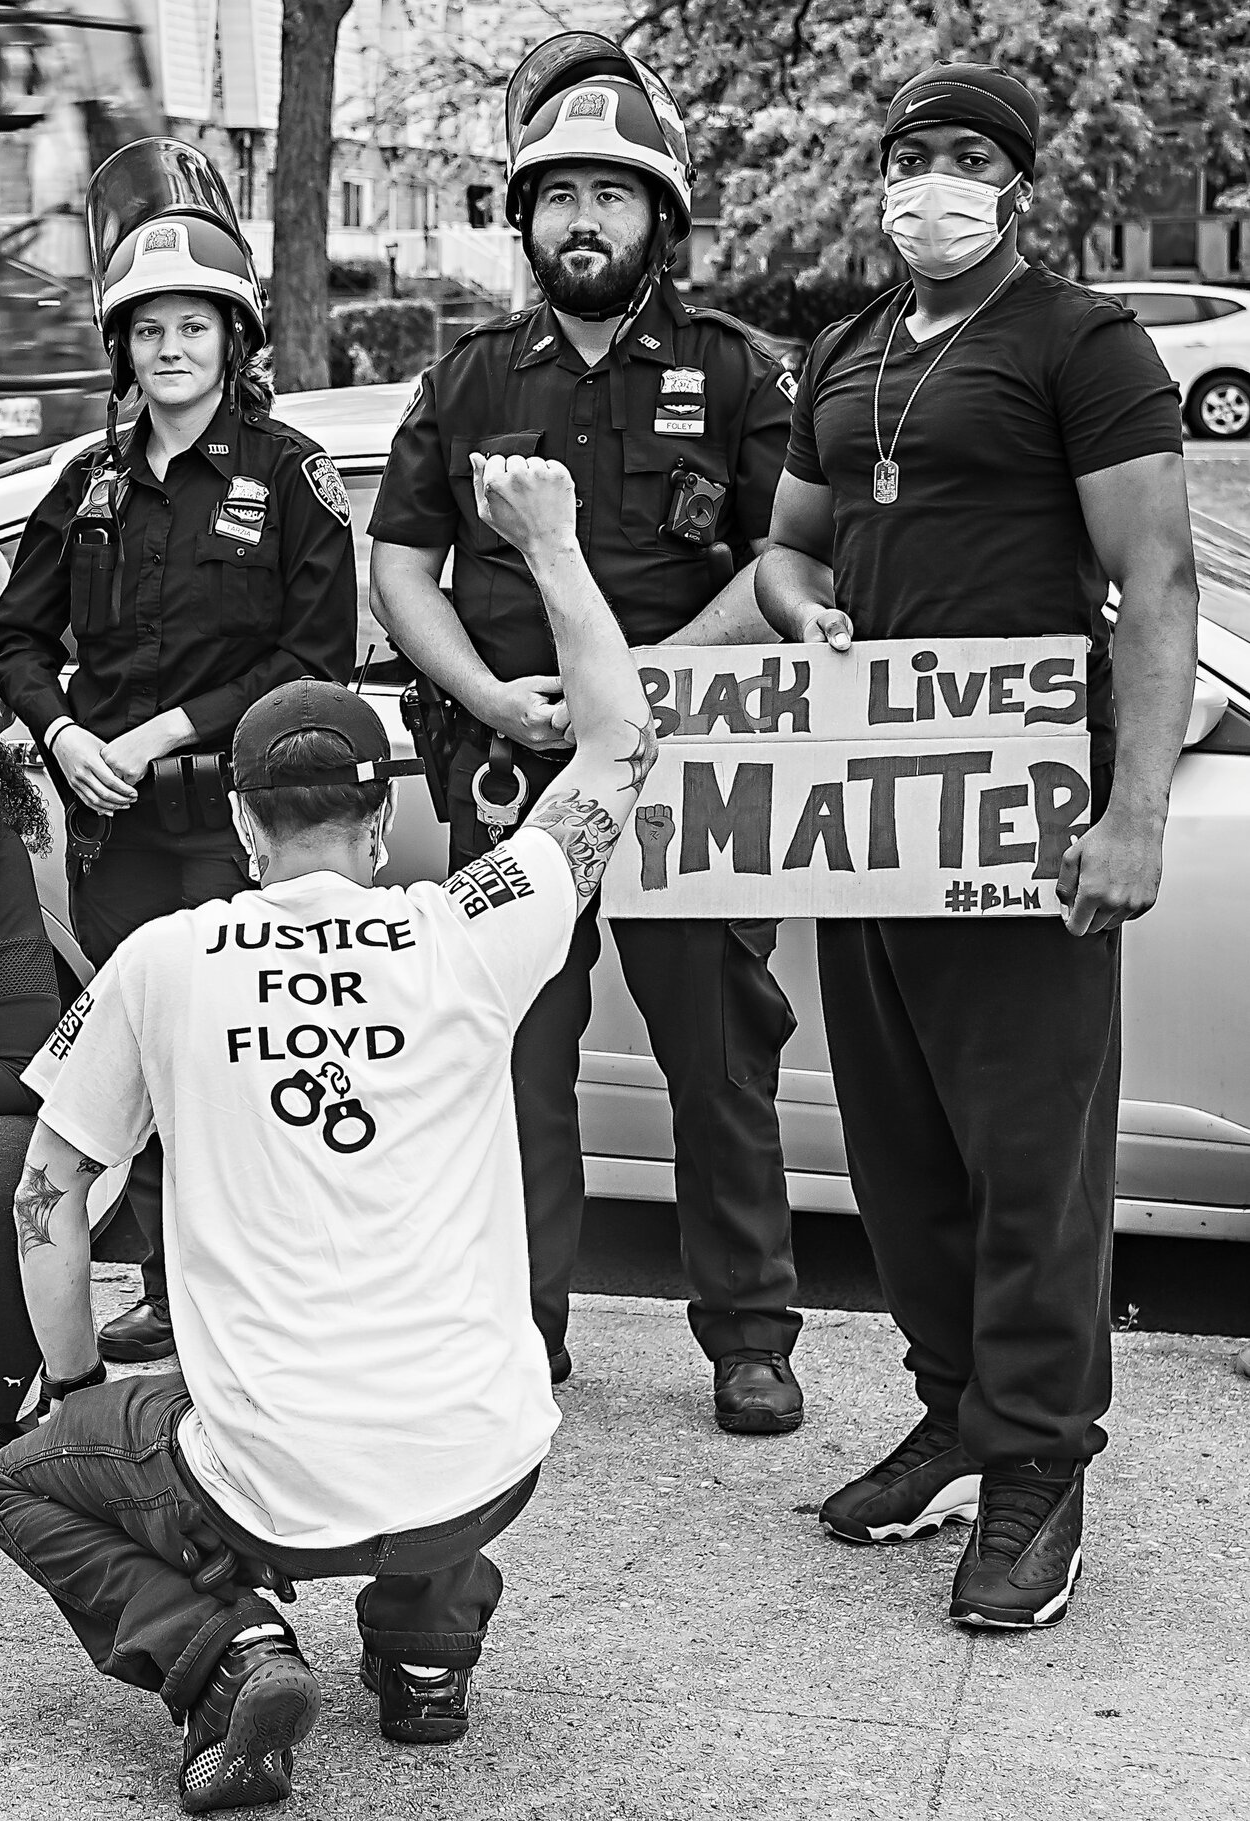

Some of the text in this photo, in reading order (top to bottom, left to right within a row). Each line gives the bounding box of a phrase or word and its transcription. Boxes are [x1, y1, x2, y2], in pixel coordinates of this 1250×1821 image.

[667, 422, 693, 430] FOLEY
[318, 487, 331, 503] CITY
[227, 525, 251, 537] TARZIA
[637, 657, 811, 738] BLACK
[679, 751, 1091, 881] MATTER
[442, 873, 489, 920] BLAC
[944, 881, 1041, 915] #BLM
[206, 918, 416, 955] JUSTICE
[259, 970, 368, 1007] FOR
[227, 1024, 405, 1063] FLOYD
